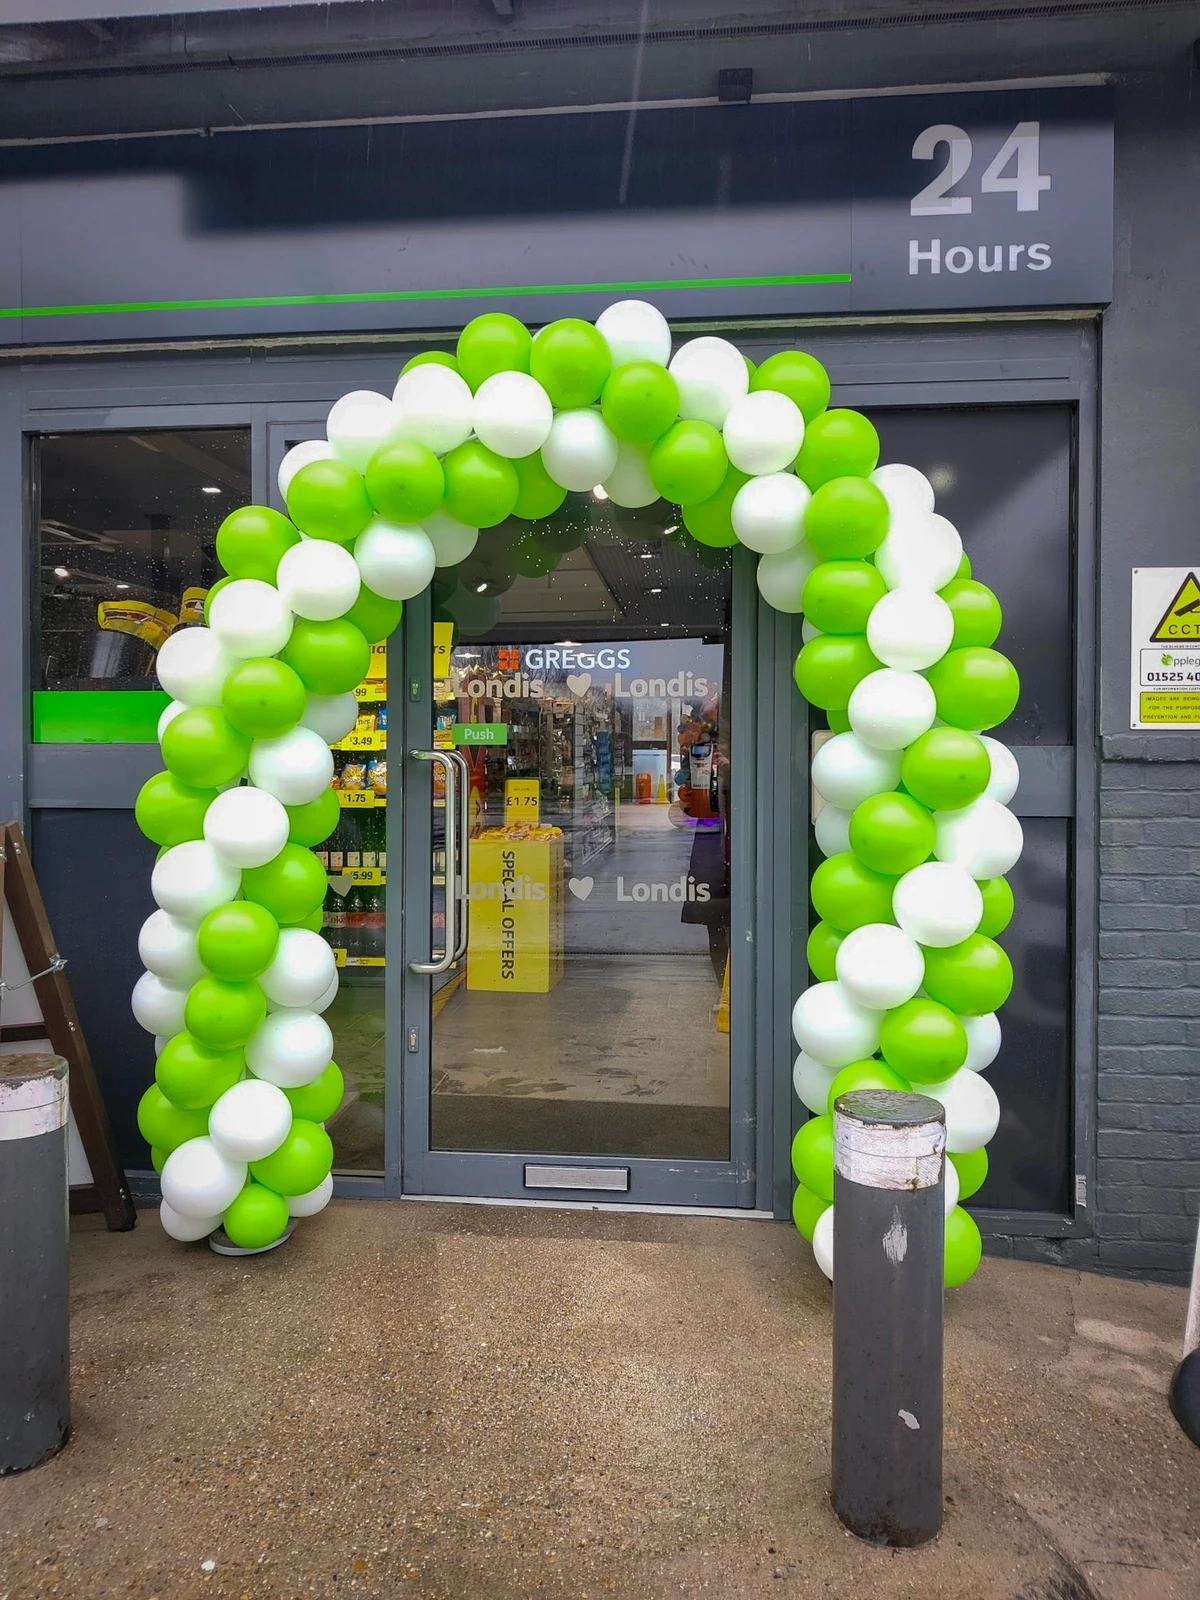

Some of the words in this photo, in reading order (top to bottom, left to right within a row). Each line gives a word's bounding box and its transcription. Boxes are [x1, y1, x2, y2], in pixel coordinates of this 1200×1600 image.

[910, 121, 1051, 216] 24
[908, 239, 1052, 275] Hours
[525, 648, 631, 670] GREGGS
[453, 672, 543, 698] Londis
[614, 671, 708, 698] Londis
[1147, 672, 1184, 682] 01525
[464, 728, 494, 740] Push
[507, 796, 538, 806] £1.75
[455, 875, 547, 901] Londis
[616, 875, 711, 902] Londis
[502, 917, 515, 980] OFFERS
